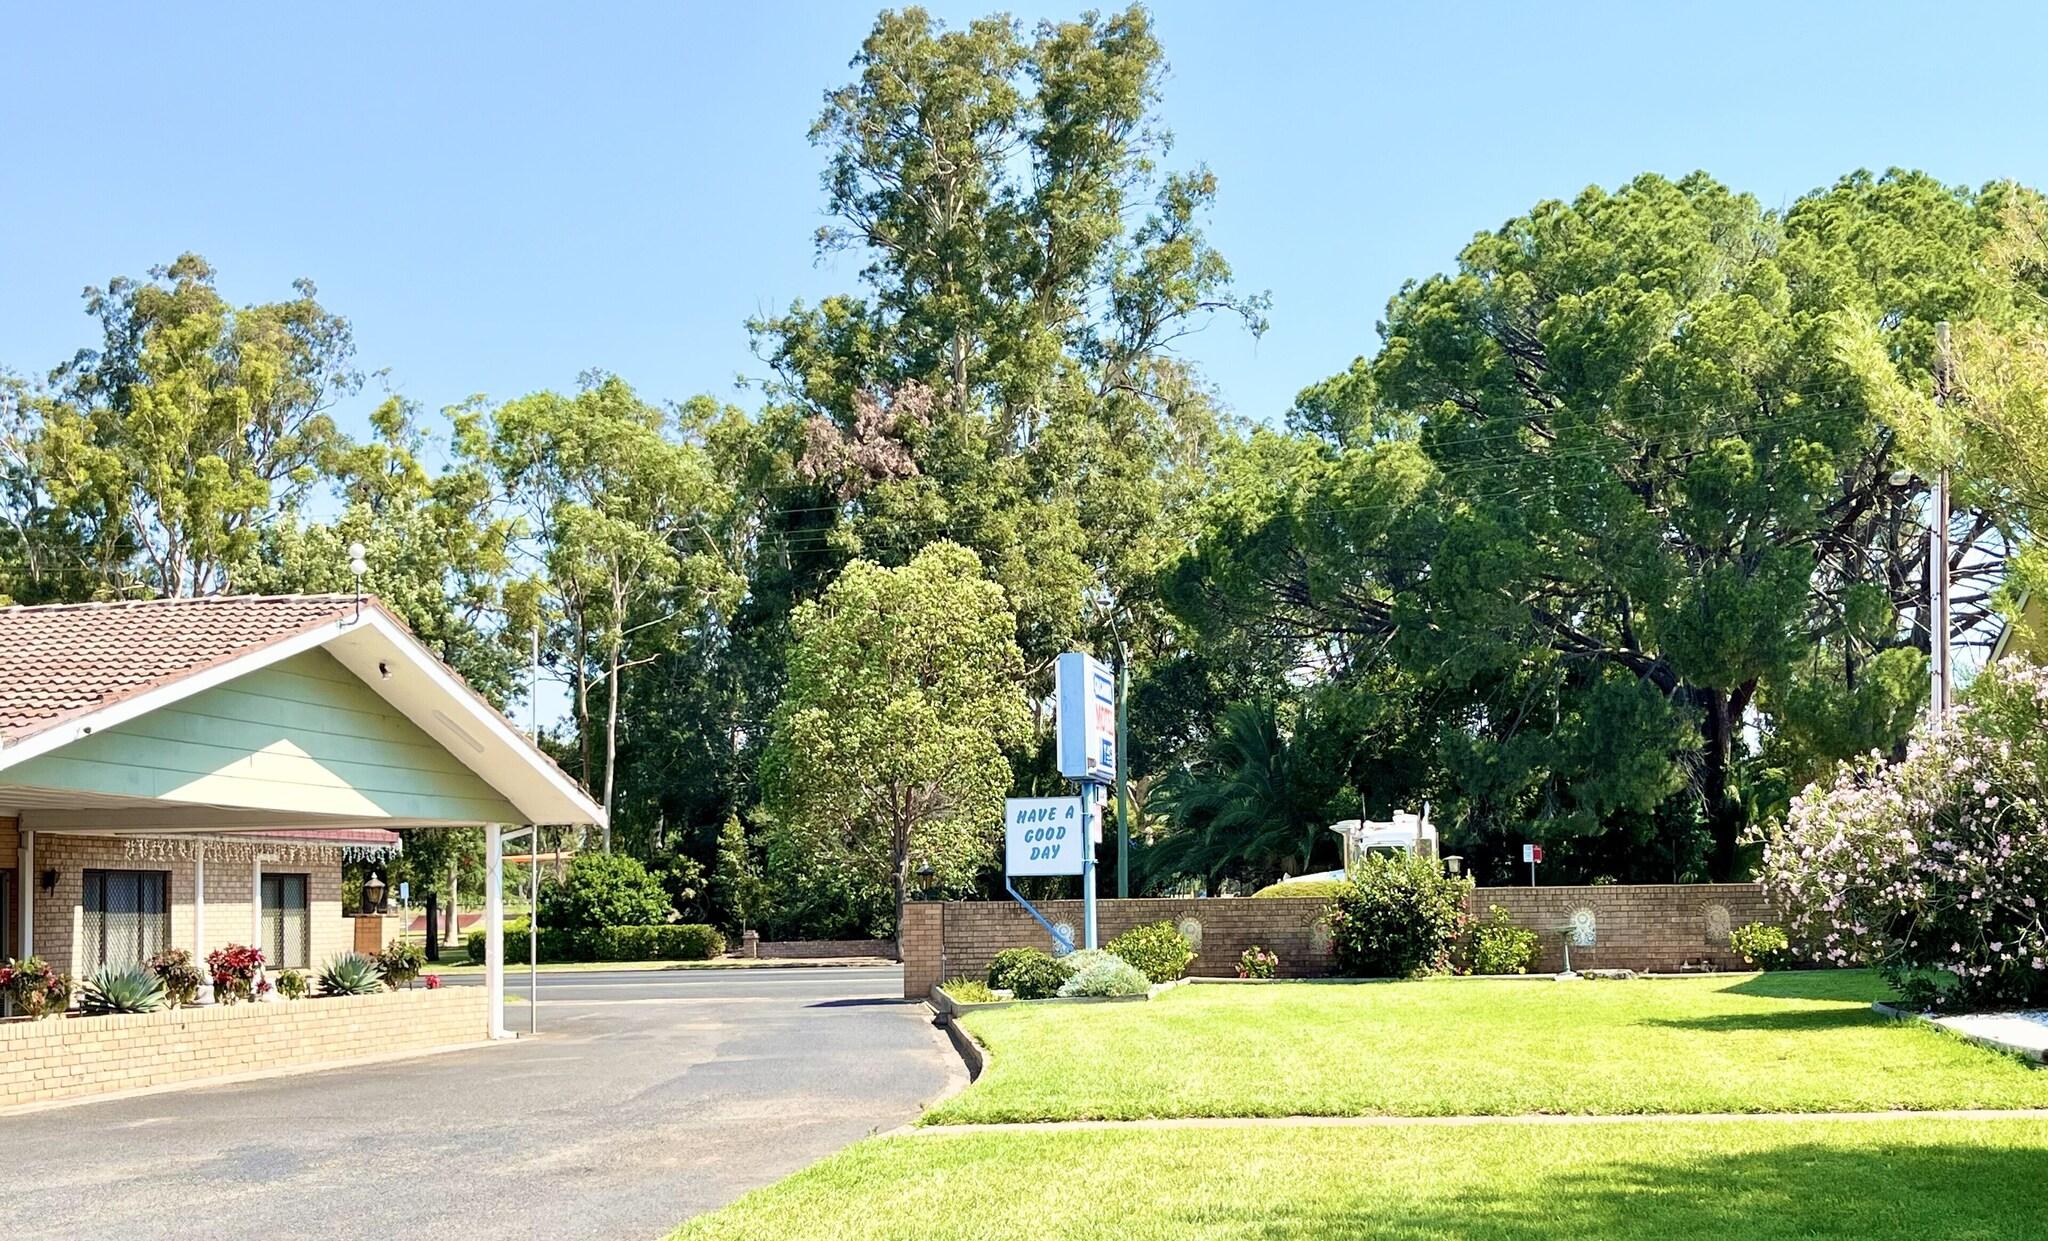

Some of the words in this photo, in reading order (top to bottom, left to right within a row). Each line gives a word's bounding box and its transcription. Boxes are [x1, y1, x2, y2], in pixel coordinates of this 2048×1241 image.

[1016, 806, 1057, 824] HAVE
[1065, 805, 1075, 819] A
[1024, 826, 1066, 843] GOOD
[1030, 844, 1061, 861] DAY
